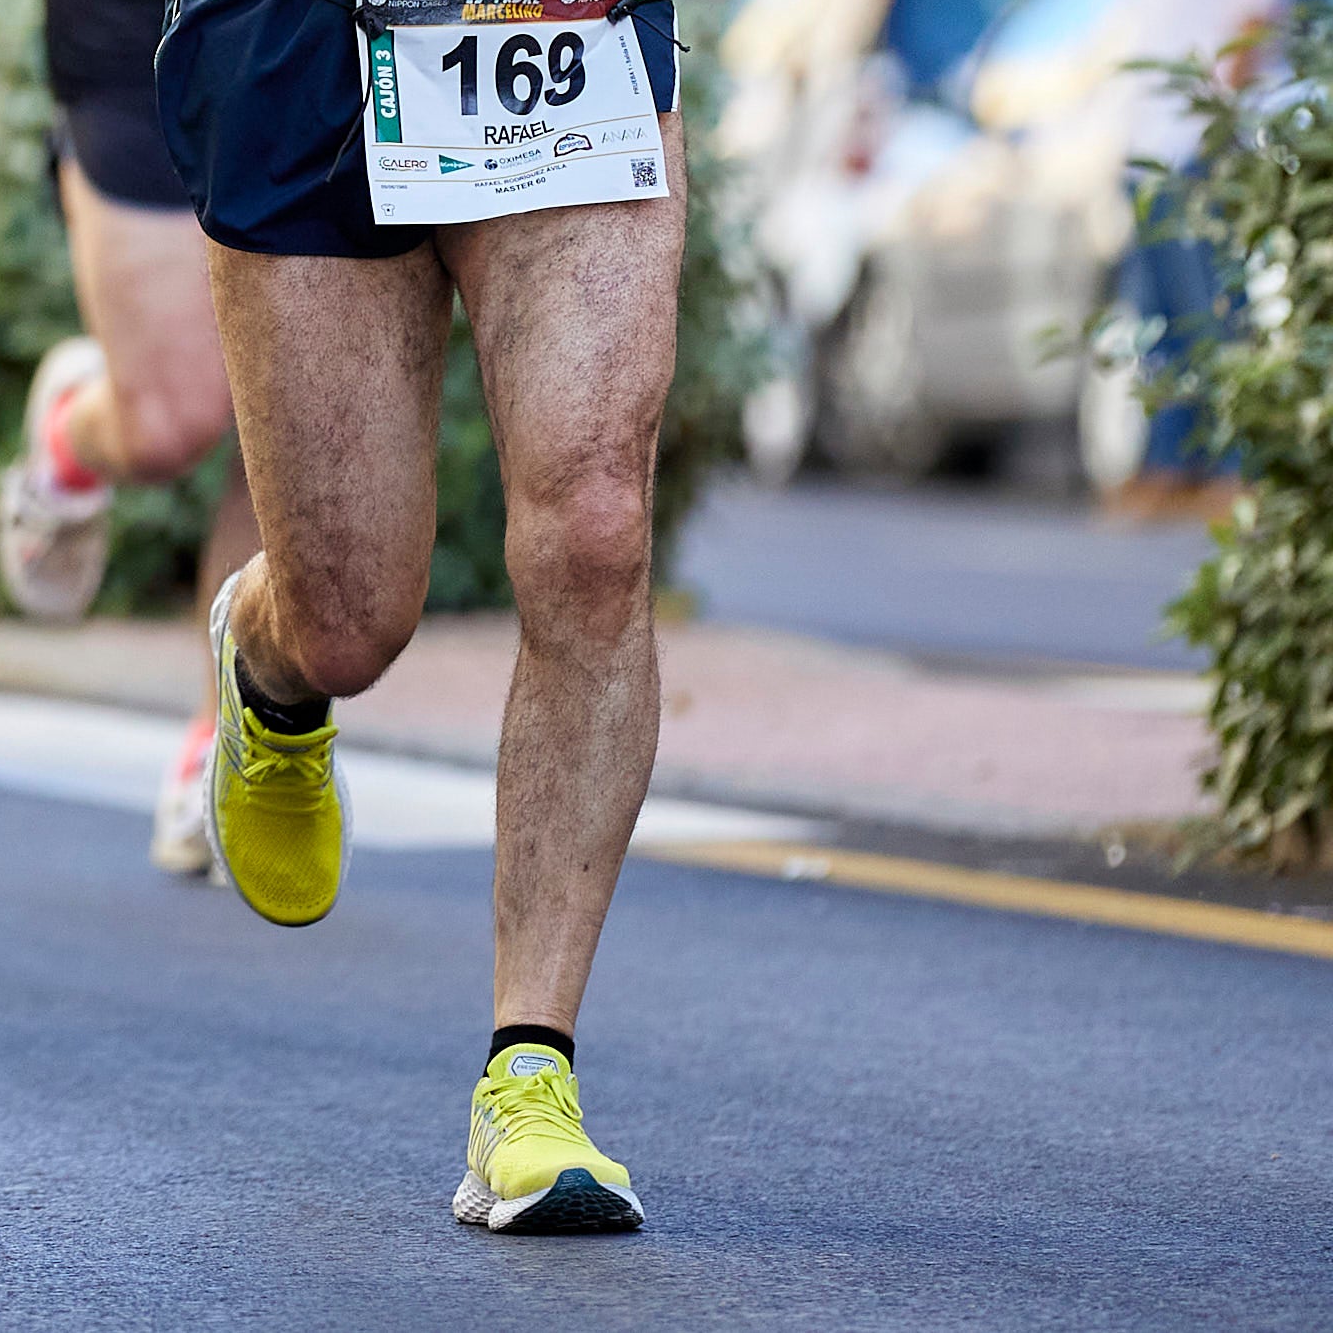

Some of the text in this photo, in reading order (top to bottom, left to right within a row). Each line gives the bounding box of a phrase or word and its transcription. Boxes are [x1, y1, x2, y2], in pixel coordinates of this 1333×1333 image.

[388, 0, 420, 8] NIPPON
[461, 4, 544, 20] MARCELINO
[441, 31, 587, 117] 169
[376, 49, 396, 119] CAJÓN 3
[483, 120, 555, 145] RAFAEL
[382, 158, 428, 169] CALERO
[499, 148, 542, 164] OXIMESA
[495, 176, 546, 194] MASTER 60
